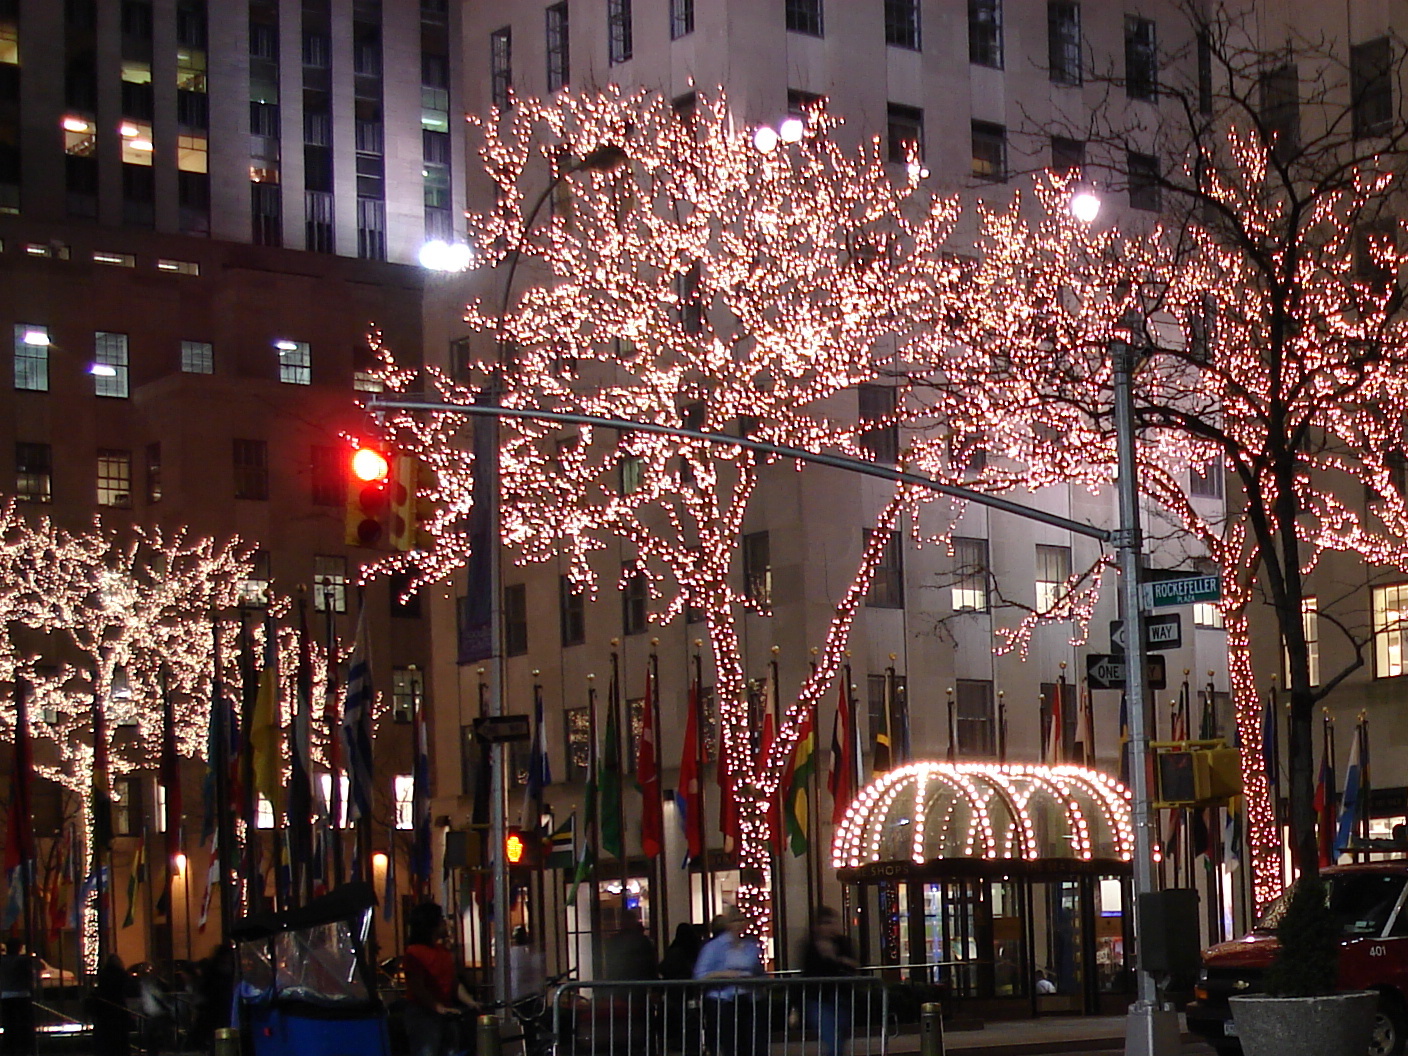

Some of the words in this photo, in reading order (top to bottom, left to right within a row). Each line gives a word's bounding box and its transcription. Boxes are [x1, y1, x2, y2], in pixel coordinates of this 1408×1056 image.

[1155, 578, 1217, 599] ROCKEFELLER
[1151, 626, 1173, 640] WAY
[1098, 664, 1120, 679] ONE
[870, 865, 909, 876] SHOPS
[1370, 946, 1387, 957] 401
